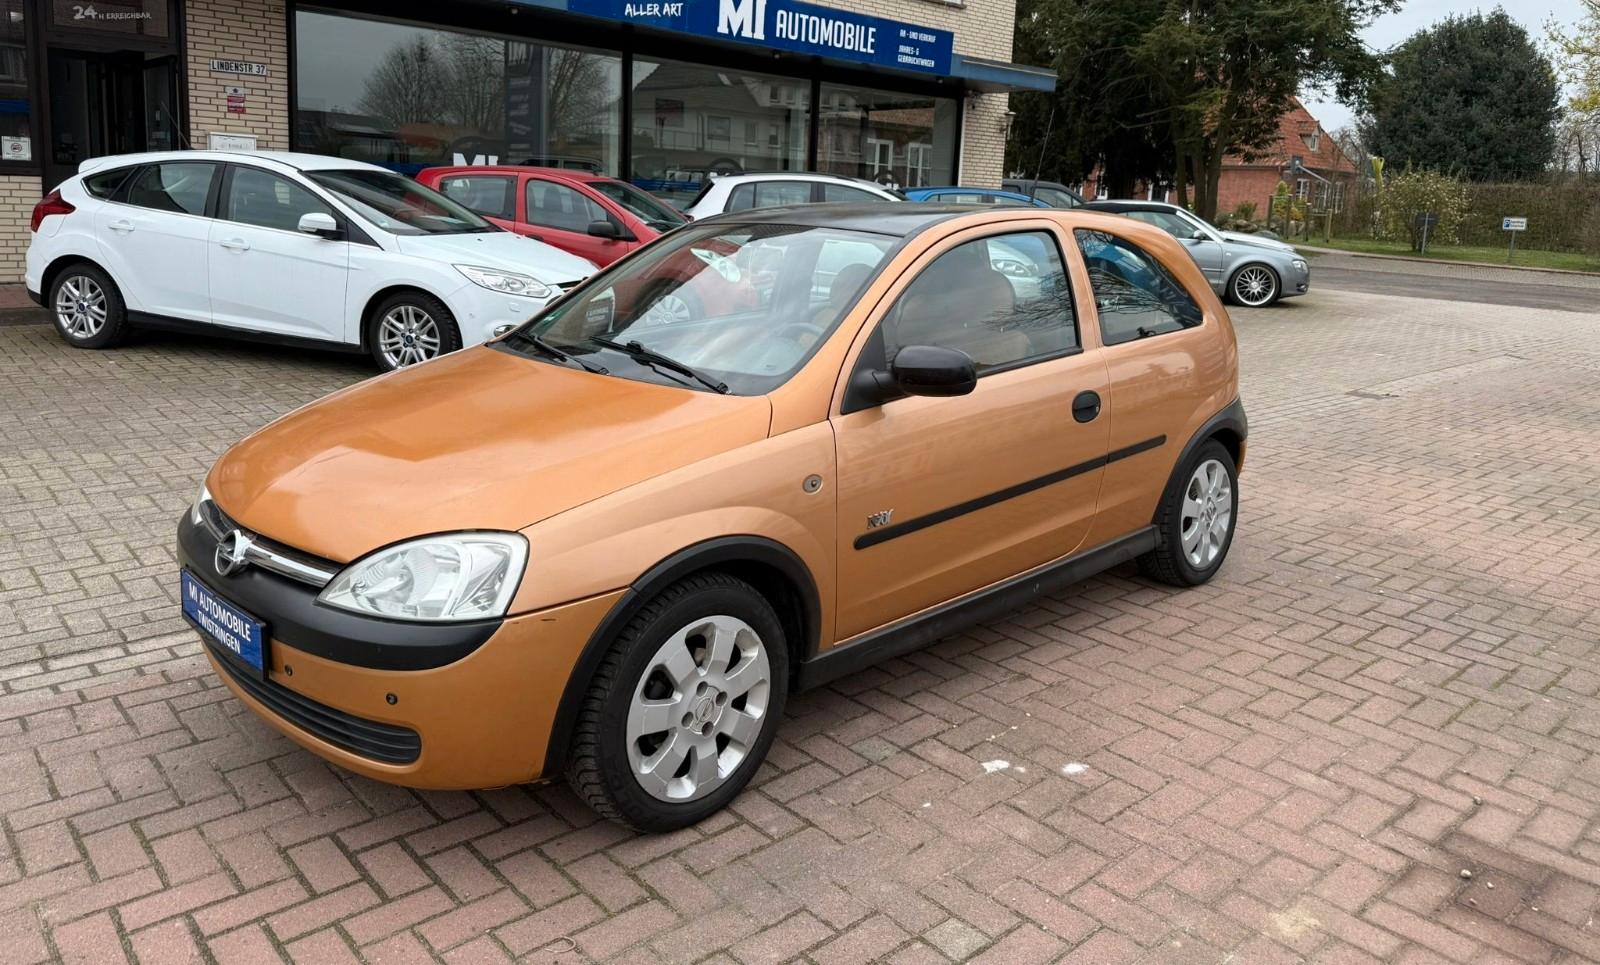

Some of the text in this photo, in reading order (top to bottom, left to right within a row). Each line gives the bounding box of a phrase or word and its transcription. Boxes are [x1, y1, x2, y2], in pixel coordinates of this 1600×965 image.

[73, 5, 97, 19] 24
[106, 12, 152, 20] ERREICHBAR
[625, 3, 684, 17] ALLER ART
[717, 0, 876, 54] MI AUTOMOBILE
[212, 60, 265, 74] LINDENSTR 37
[188, 581, 251, 643] MI AUTOMOBILE
[197, 609, 241, 655] TWISTRINGEN
